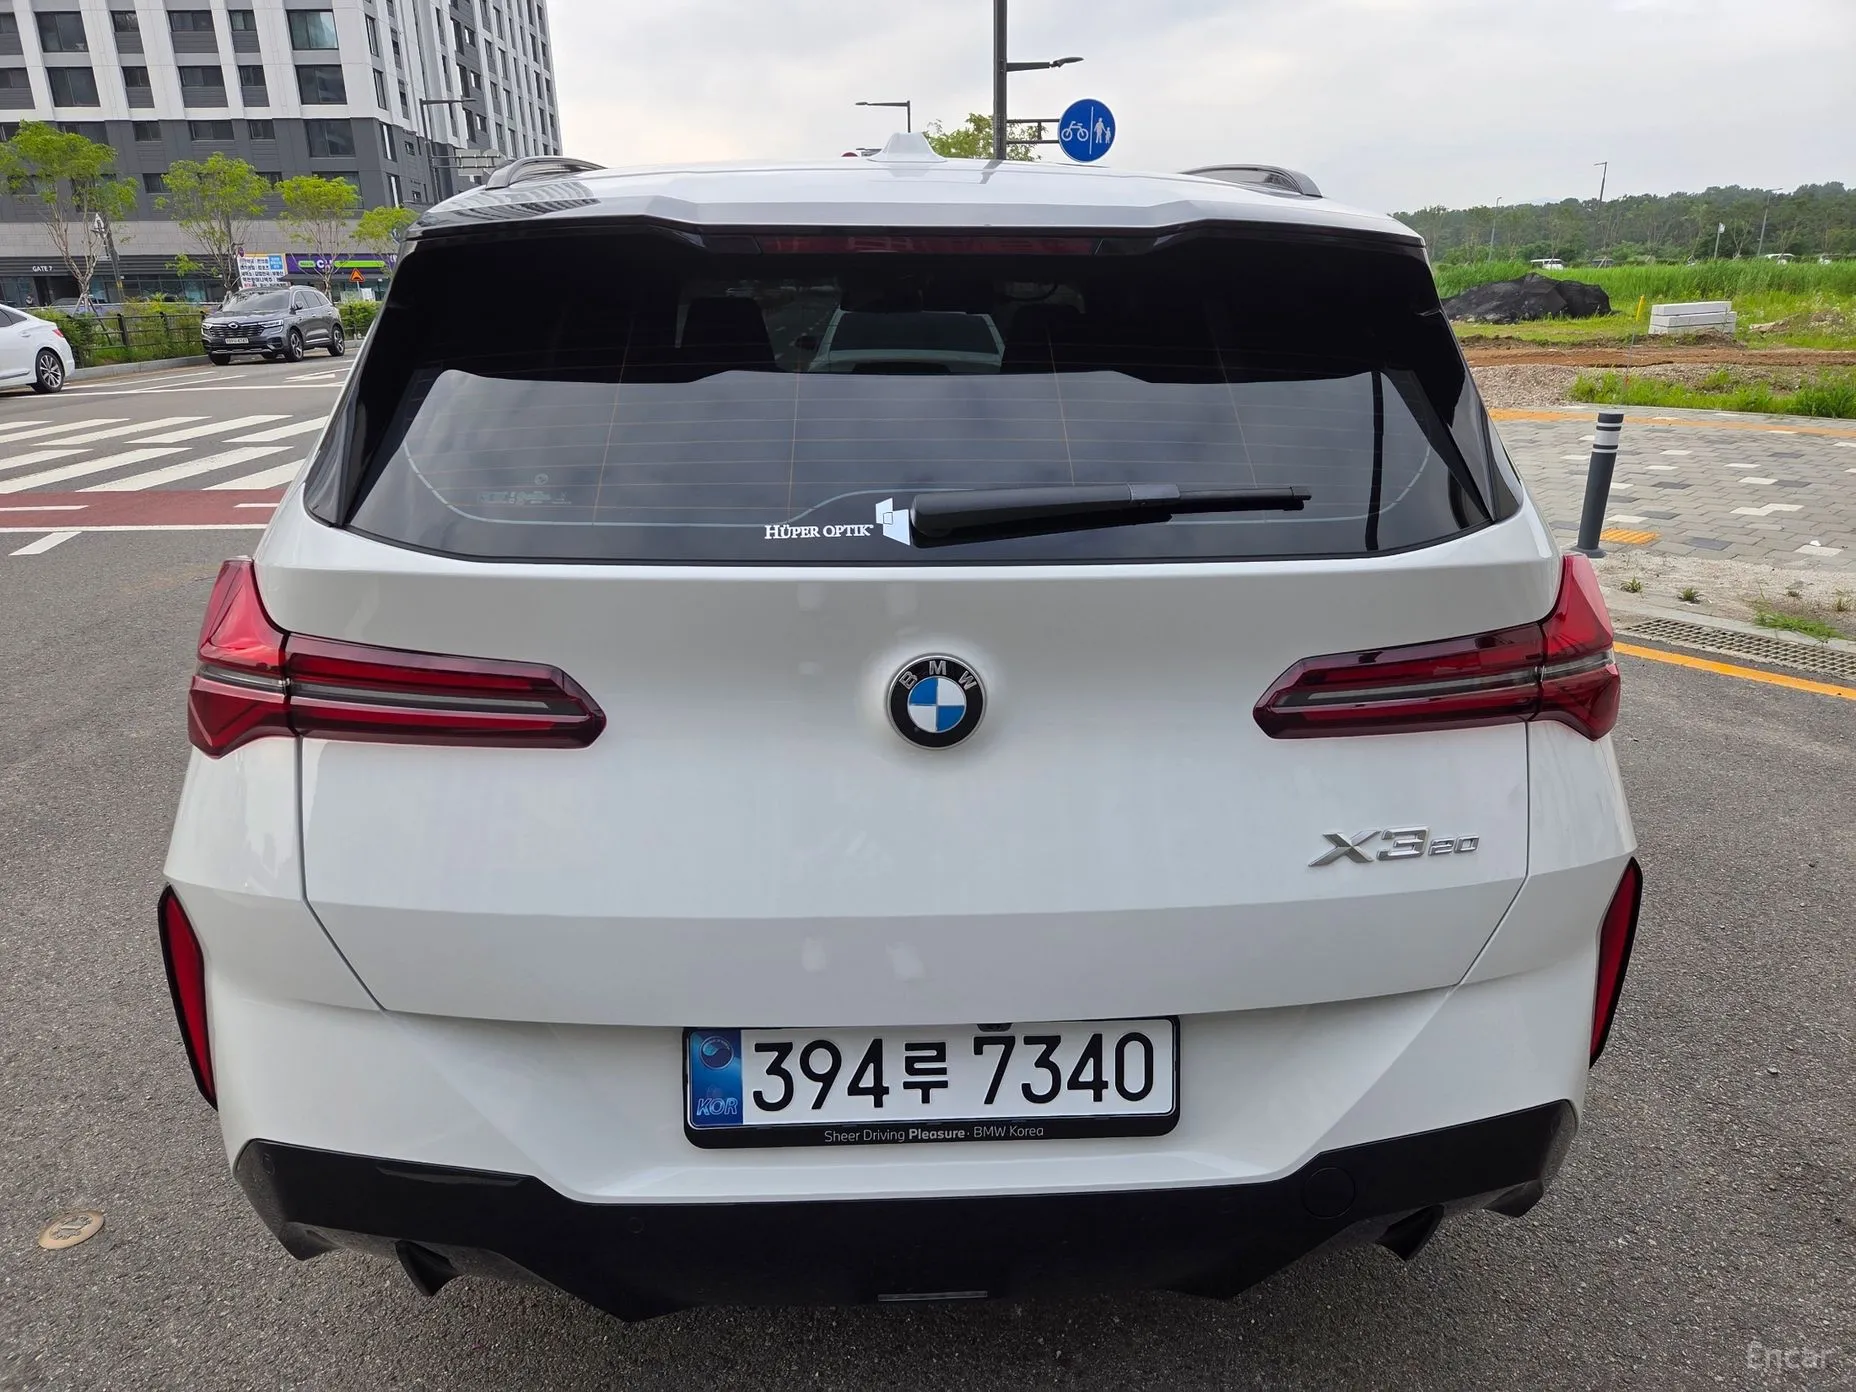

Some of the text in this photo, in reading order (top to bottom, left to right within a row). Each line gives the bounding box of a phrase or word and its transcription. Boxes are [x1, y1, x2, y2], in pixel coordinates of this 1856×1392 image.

[764, 524, 872, 539] HÜPER OPTIK
[898, 660, 977, 691] BMW
[972, 1031, 1153, 1105] 7340
[696, 1097, 738, 1116] KOR
[824, 1125, 1044, 1143] Sheer Driving Pleasure BMW Korea
